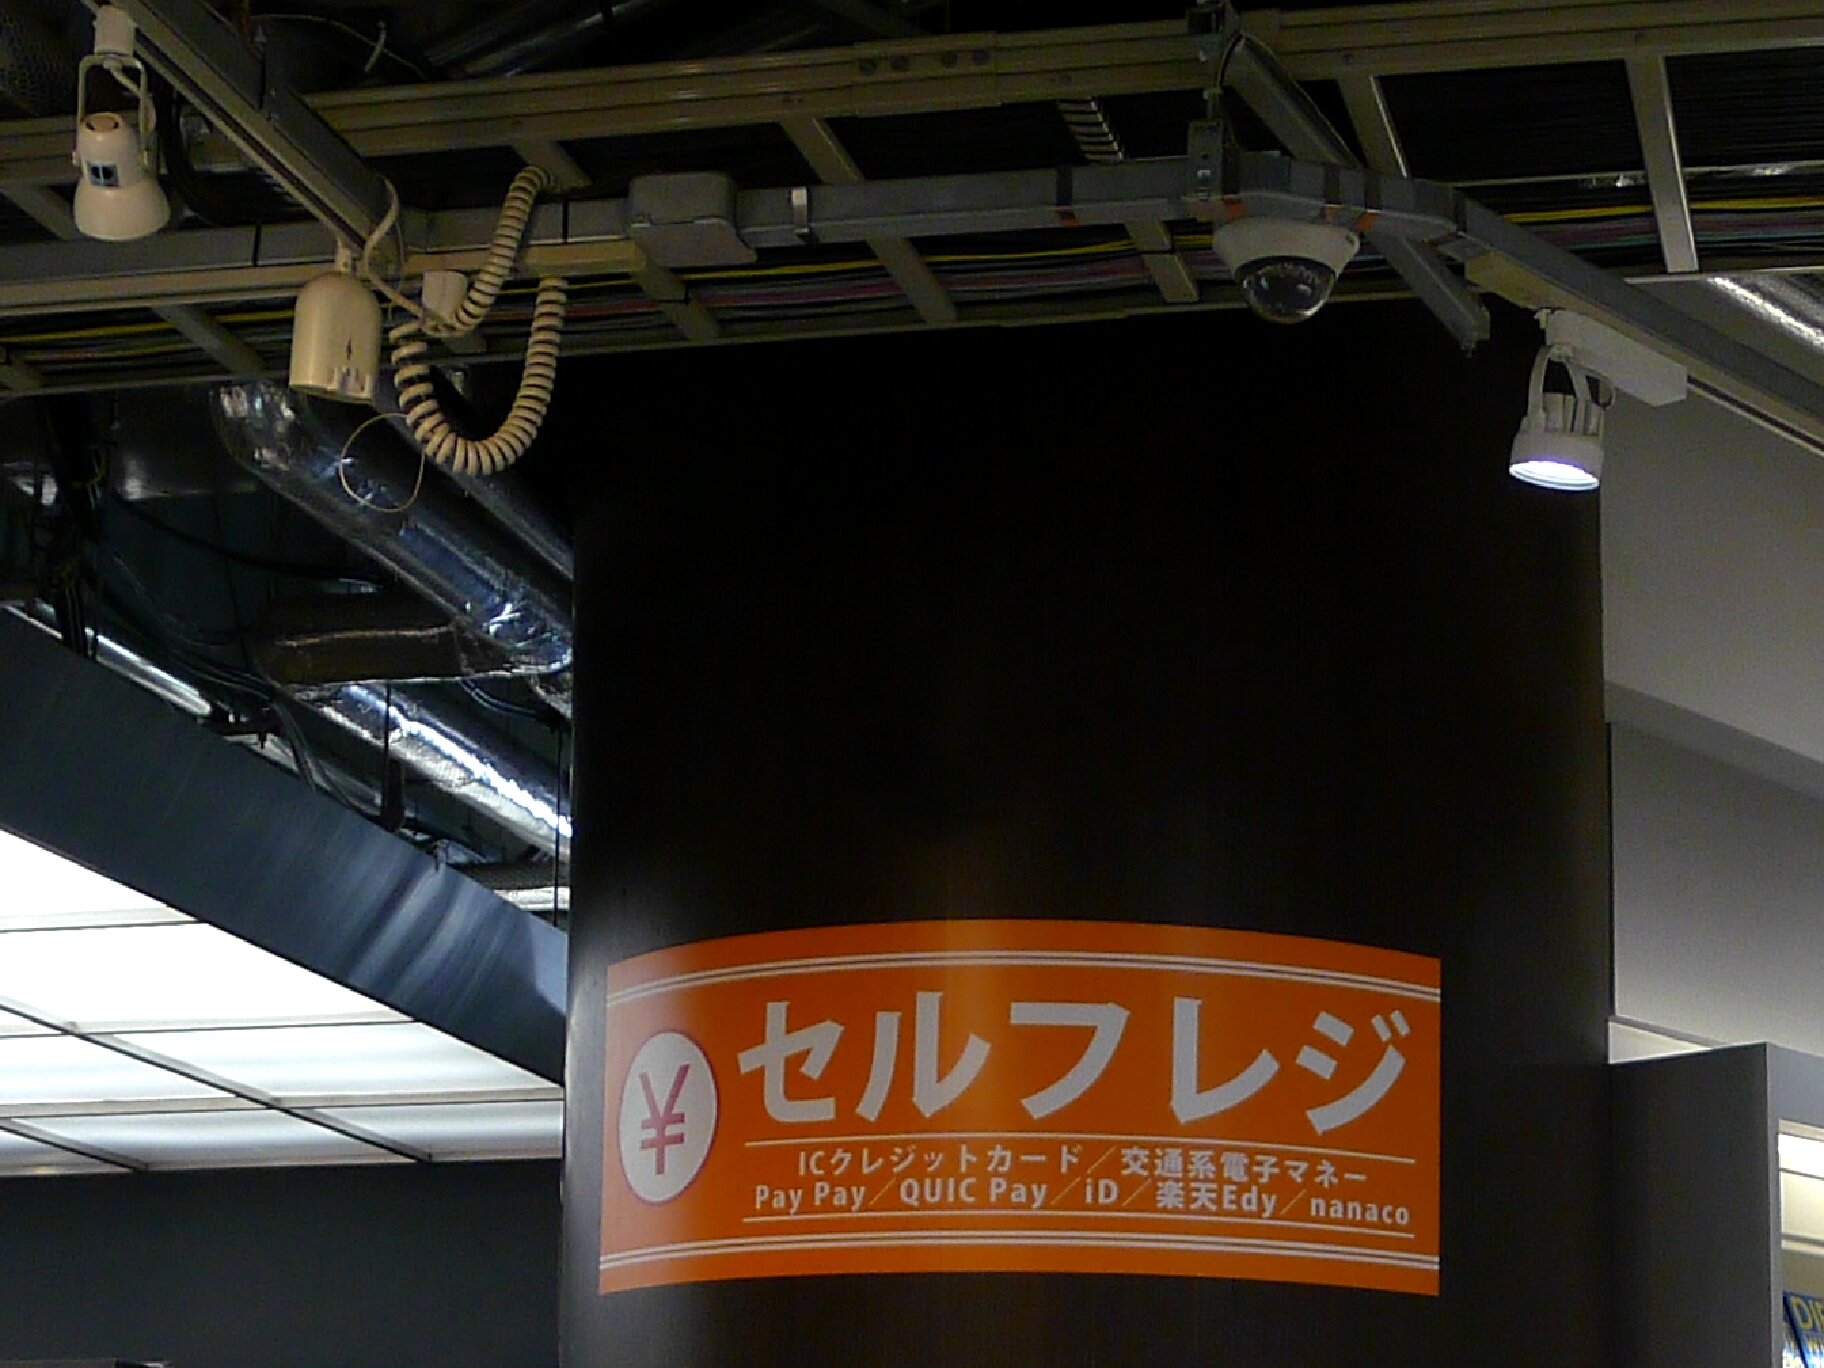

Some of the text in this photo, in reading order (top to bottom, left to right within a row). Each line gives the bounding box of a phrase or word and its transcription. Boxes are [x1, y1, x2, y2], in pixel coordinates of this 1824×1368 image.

[737, 991, 1413, 1136] セルフレジ
[755, 1184, 803, 1216] Pay
